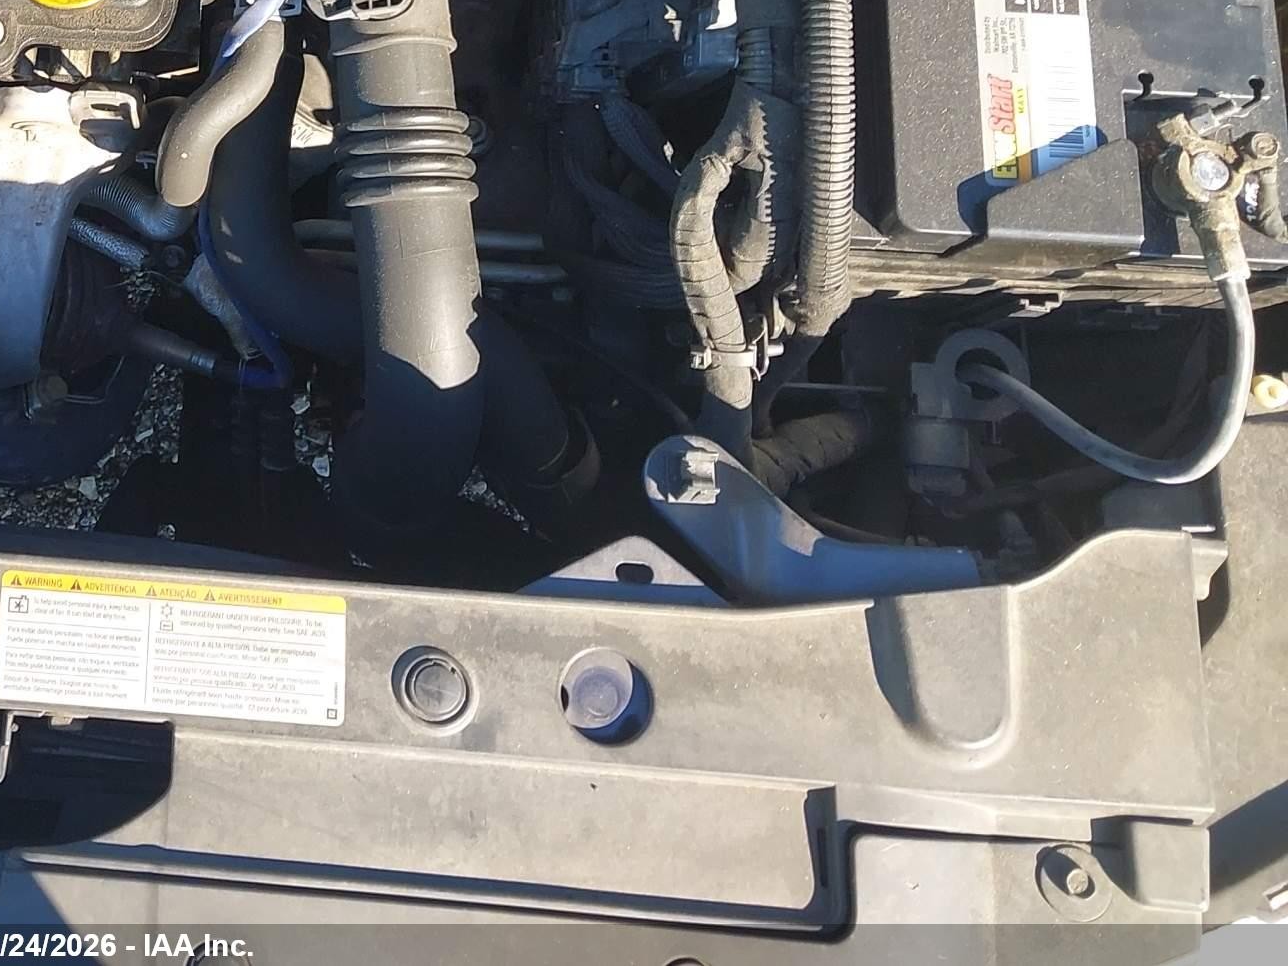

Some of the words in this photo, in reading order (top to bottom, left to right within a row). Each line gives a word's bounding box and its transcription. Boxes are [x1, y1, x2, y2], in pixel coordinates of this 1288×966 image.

[986, 73, 1019, 179] EStart
[24, 576, 63, 588] WARNING
[84, 581, 137, 594] ADVERTENCIA
[159, 586, 197, 600] ATENÇÃO
[218, 592, 283, 606] AVERTISSEMENT
